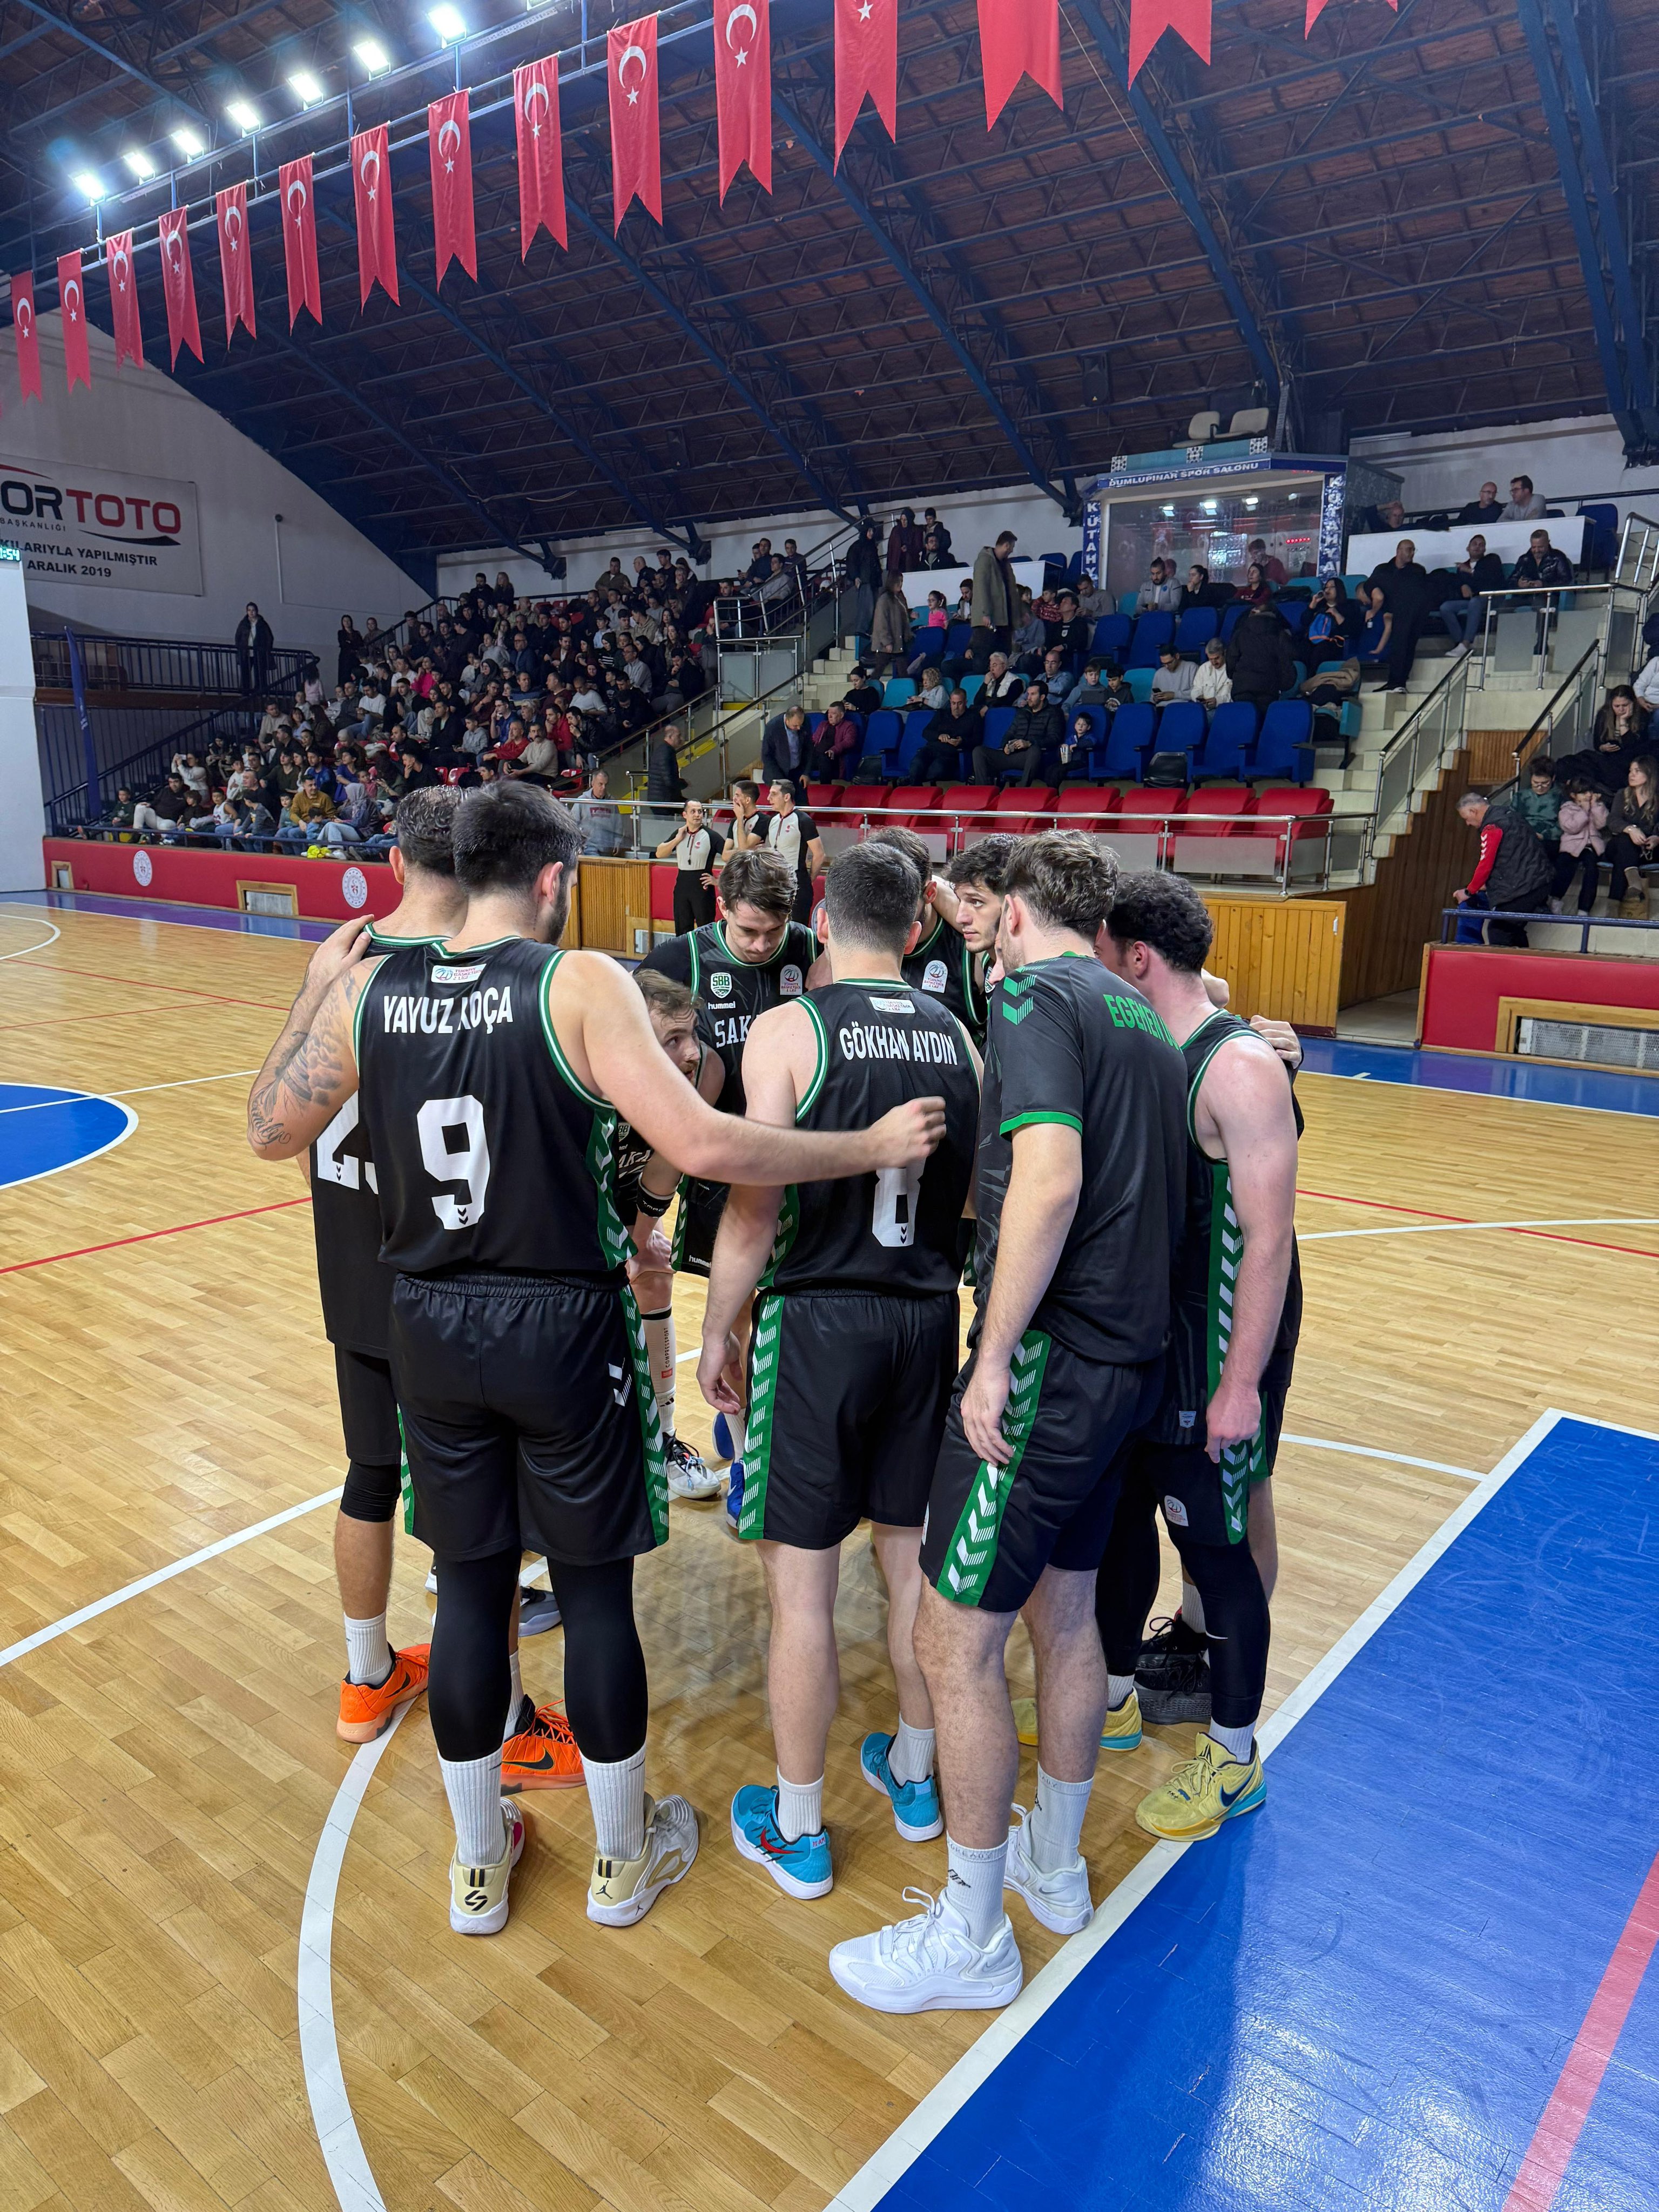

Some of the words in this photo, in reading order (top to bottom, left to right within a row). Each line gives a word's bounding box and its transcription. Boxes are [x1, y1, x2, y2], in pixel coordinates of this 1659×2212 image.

[1109, 473, 1177, 487] DUMLUPINAR
[1181, 468, 1210, 478] SPOR
[1213, 462, 1259, 474] SALONU
[1085, 502, 1099, 579] KÜTAHY
[28, 559, 77, 574] ARALIK
[81, 565, 111, 577] 2019
[77, 548, 158, 566] YAPILMIŞTIR
[712, 975, 730, 987] SBB
[457, 986, 514, 1034] KOÇA
[707, 1001, 736, 1010] hummel
[714, 1014, 757, 1048] SAK
[839, 1021, 910, 1061] GÖKHAN
[912, 1030, 958, 1065] AYDIN
[317, 1090, 379, 1195] 2
[416, 1094, 490, 1230] 9
[689, 1255, 712, 1269] hummel
